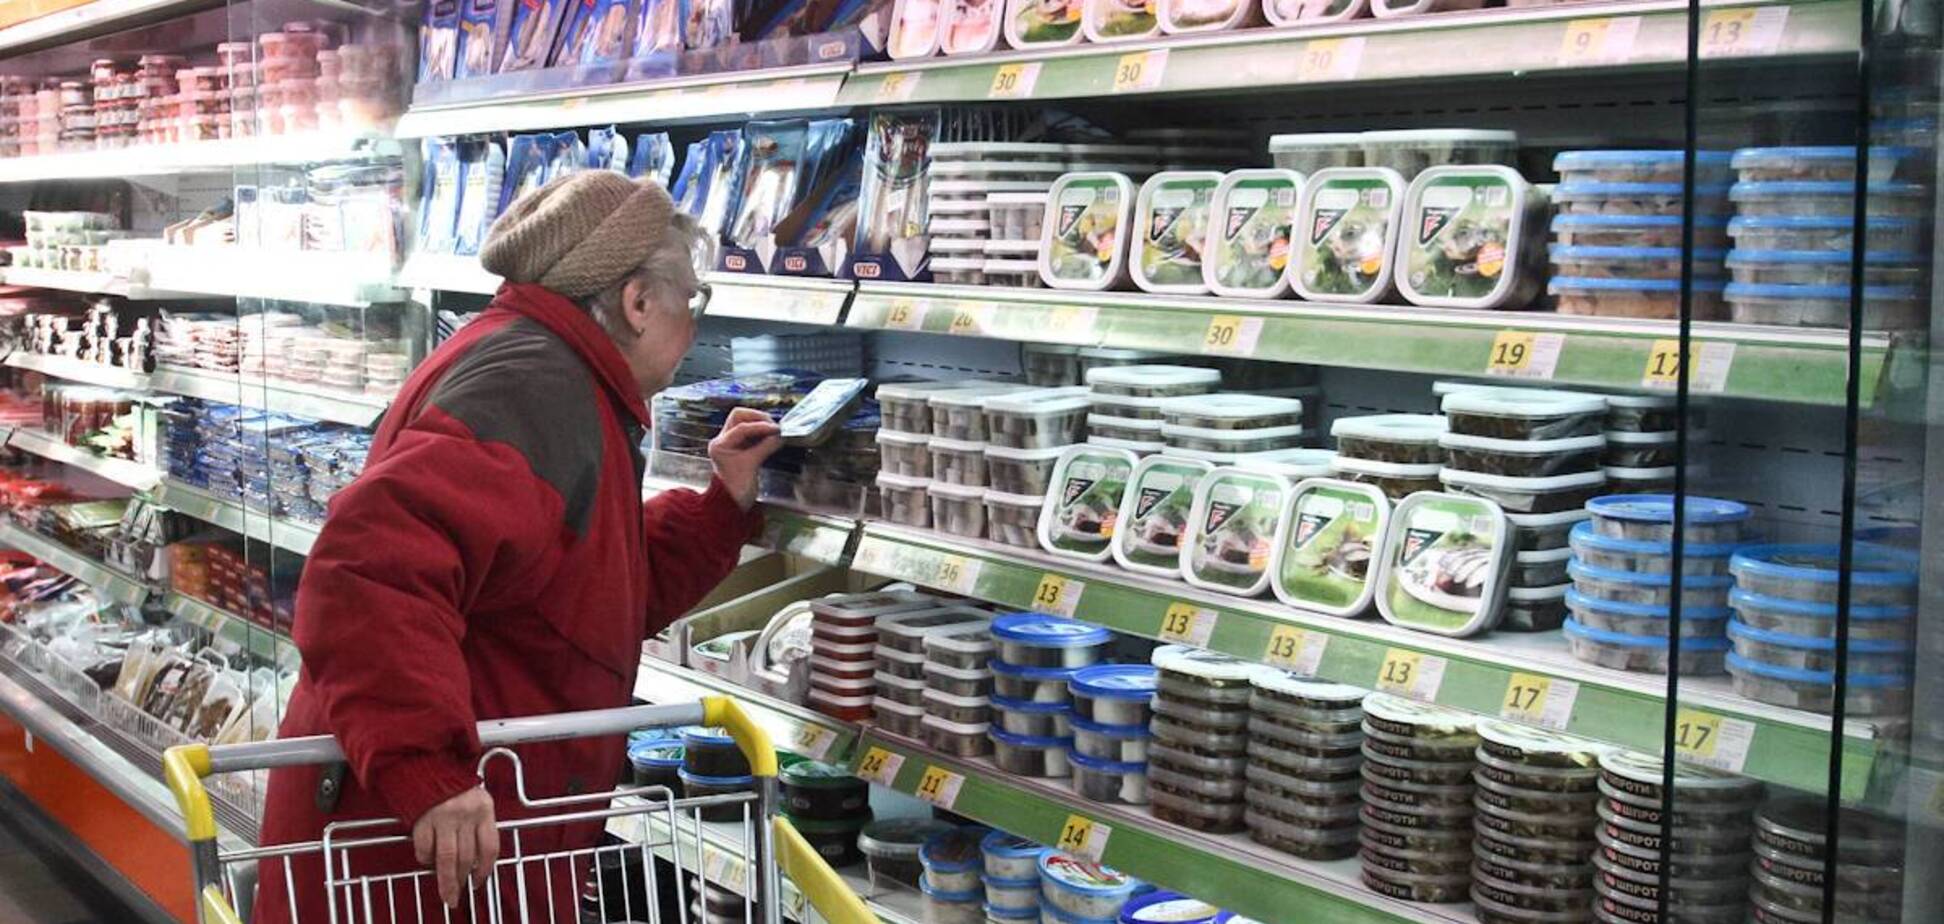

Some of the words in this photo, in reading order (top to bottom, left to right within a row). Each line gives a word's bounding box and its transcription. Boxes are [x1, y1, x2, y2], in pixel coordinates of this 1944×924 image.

[1573, 30, 1591, 54] 9
[1707, 21, 1742, 45] 13
[996, 72, 1017, 91] 30
[1118, 63, 1141, 84] 30
[1207, 325, 1233, 345] 30
[1494, 343, 1525, 365] 19
[1038, 584, 1059, 604] 13
[1165, 613, 1189, 635] 13
[1270, 635, 1295, 659] 13
[1383, 660, 1411, 684] 13
[1508, 685, 1541, 710] 17
[1676, 722, 1711, 750] 17
[863, 755, 882, 772] 24
[922, 775, 940, 794] 11
[1064, 826, 1084, 846] 14
